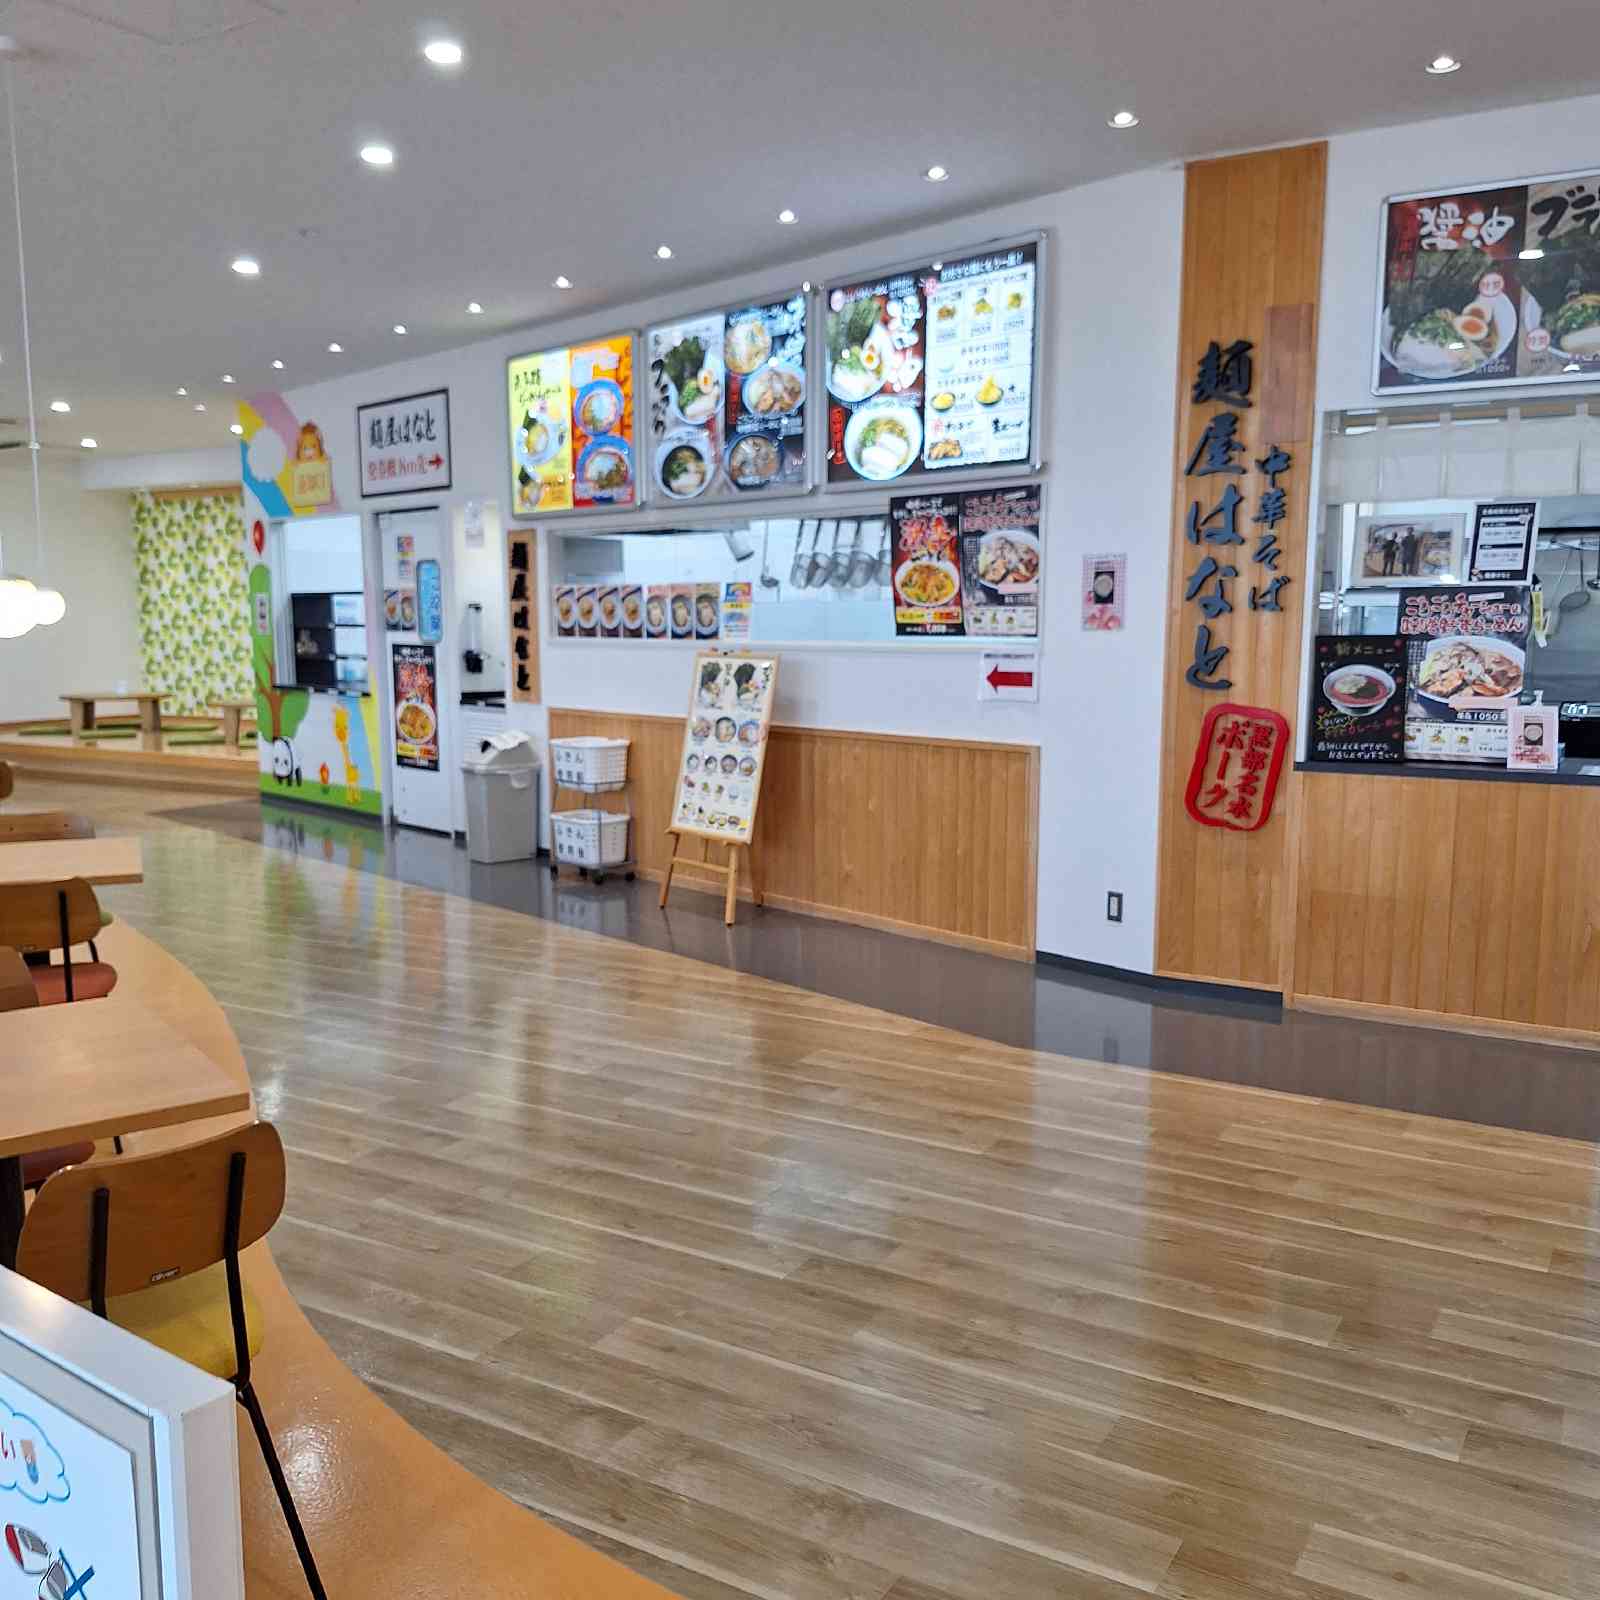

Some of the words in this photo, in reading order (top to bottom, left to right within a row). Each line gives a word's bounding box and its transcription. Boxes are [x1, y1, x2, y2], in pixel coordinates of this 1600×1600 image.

[1418, 202, 1516, 250] 醤油
[1184, 340, 1254, 691] 麺屋はなと
[1248, 444, 1292, 613] 中華そば
